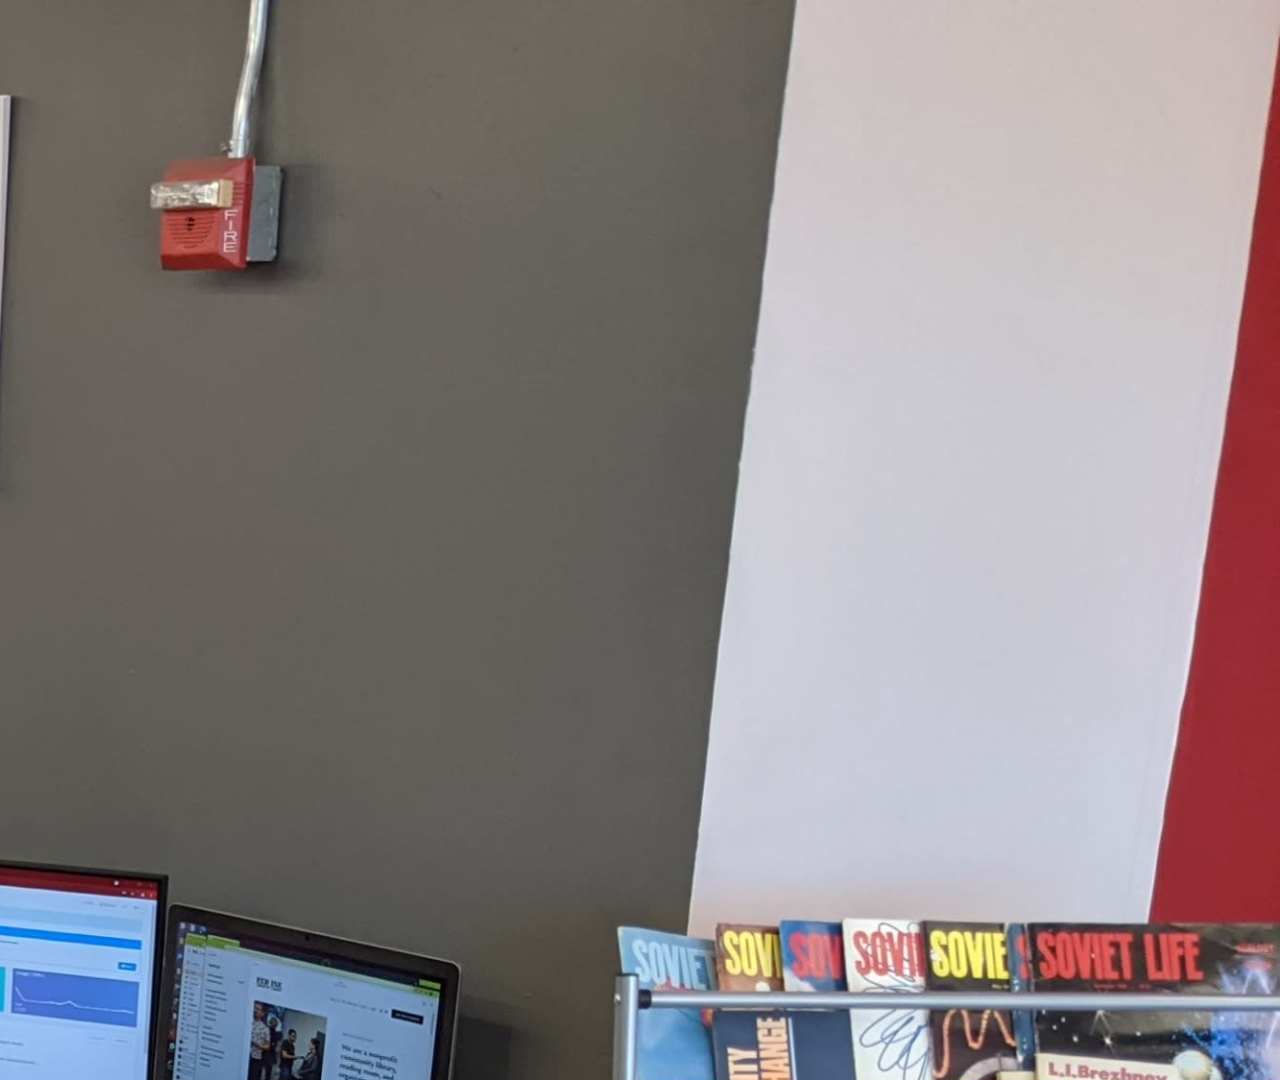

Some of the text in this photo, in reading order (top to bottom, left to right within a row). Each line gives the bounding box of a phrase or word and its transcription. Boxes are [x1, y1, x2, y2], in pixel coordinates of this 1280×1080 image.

[224, 209, 238, 253] FIRE
[1035, 931, 1204, 983] SOVIET LIFE
